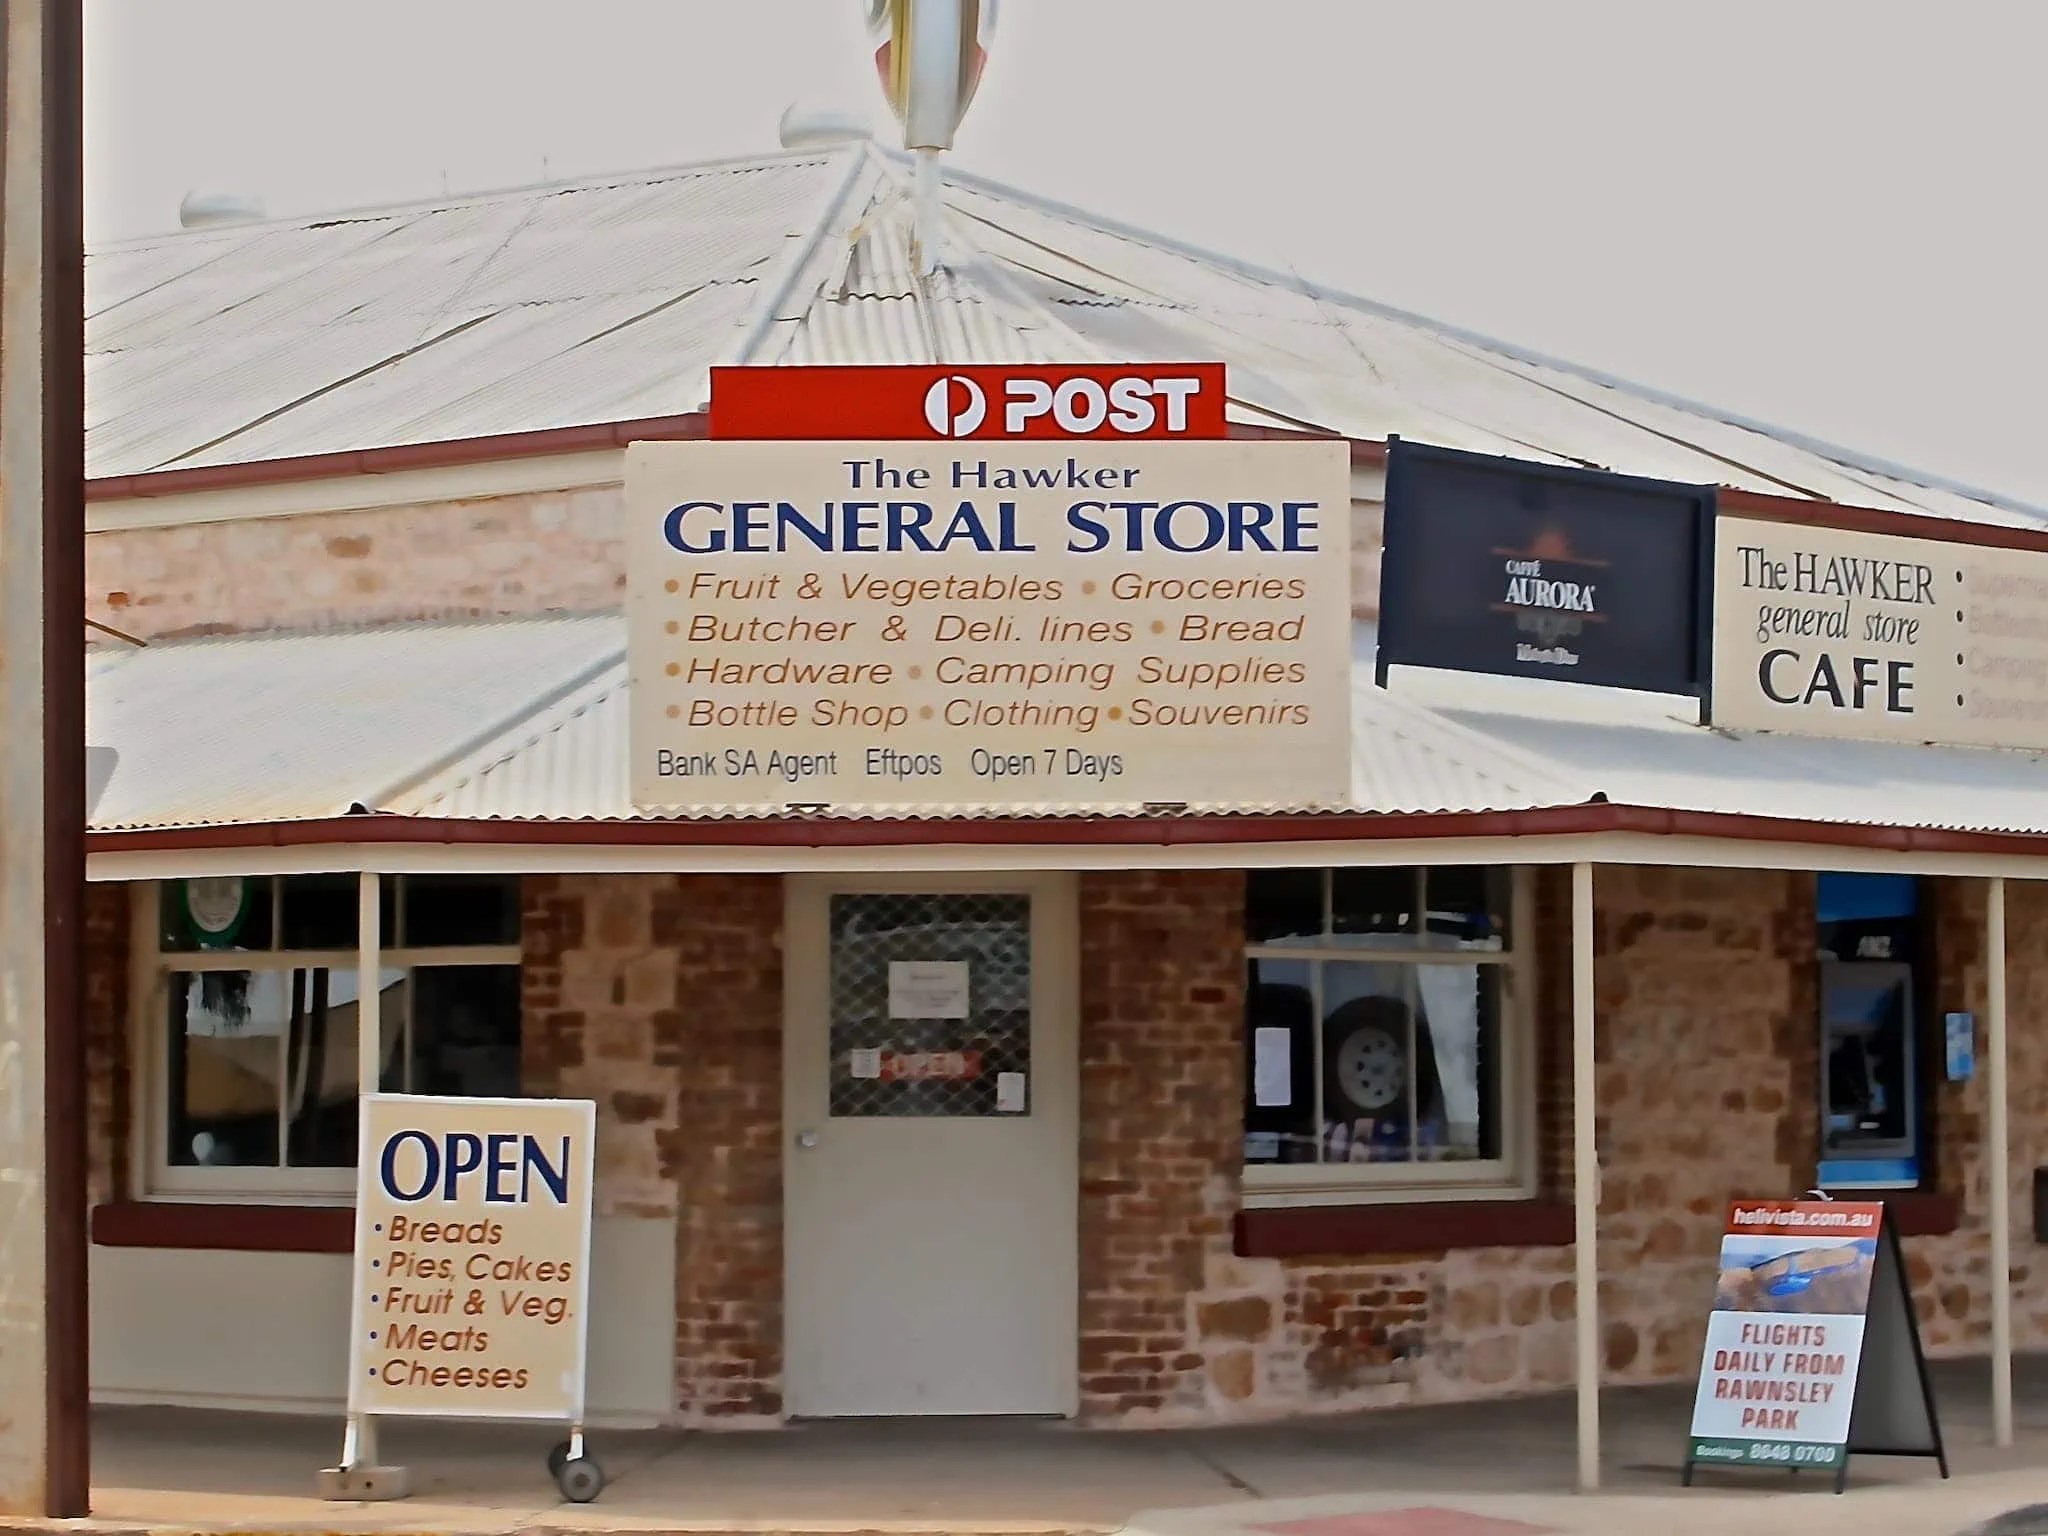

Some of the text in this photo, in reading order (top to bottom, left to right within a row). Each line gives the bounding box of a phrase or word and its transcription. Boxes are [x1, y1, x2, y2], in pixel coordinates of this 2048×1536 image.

[1005, 377, 1200, 433] POST
[842, 458, 1141, 489] The Hawker
[663, 500, 1319, 554] GENERAL STORE
[688, 572, 1063, 607] Fruit & Vegetables
[1110, 572, 1306, 601] Groceries
[1737, 546, 1787, 591] The
[1793, 552, 1936, 605] HAWKER
[1504, 576, 1594, 612] AURORA
[687, 614, 1134, 643] Butcher & Deli. lines
[1179, 614, 1305, 642] Bread
[1756, 599, 1920, 645] general store
[686, 657, 893, 684] Hardware
[935, 656, 1306, 691] Camping Supplies
[1758, 648, 1915, 713] CAFE
[687, 699, 909, 733] Bottle Shop
[943, 699, 1100, 733] Clothing
[1128, 698, 1310, 727] Souvenirs
[657, 749, 838, 783] Bank SA Agent
[866, 748, 942, 782] Eftpos
[971, 748, 1124, 783] Open 7 Days
[380, 1130, 571, 1204] OPEN
[388, 1215, 503, 1245] Breads
[465, 1253, 573, 1283] Cakes
[383, 1287, 573, 1325] Fruit & Veg.
[384, 1323, 488, 1352] Meats
[1741, 1323, 1826, 1347] FLIGHTS
[381, 1359, 529, 1389] Cheeses
[1713, 1350, 1845, 1376] DAILY FROM
[1715, 1378, 1834, 1404] RAWNSLEY
[1741, 1407, 1800, 1430] PARK
